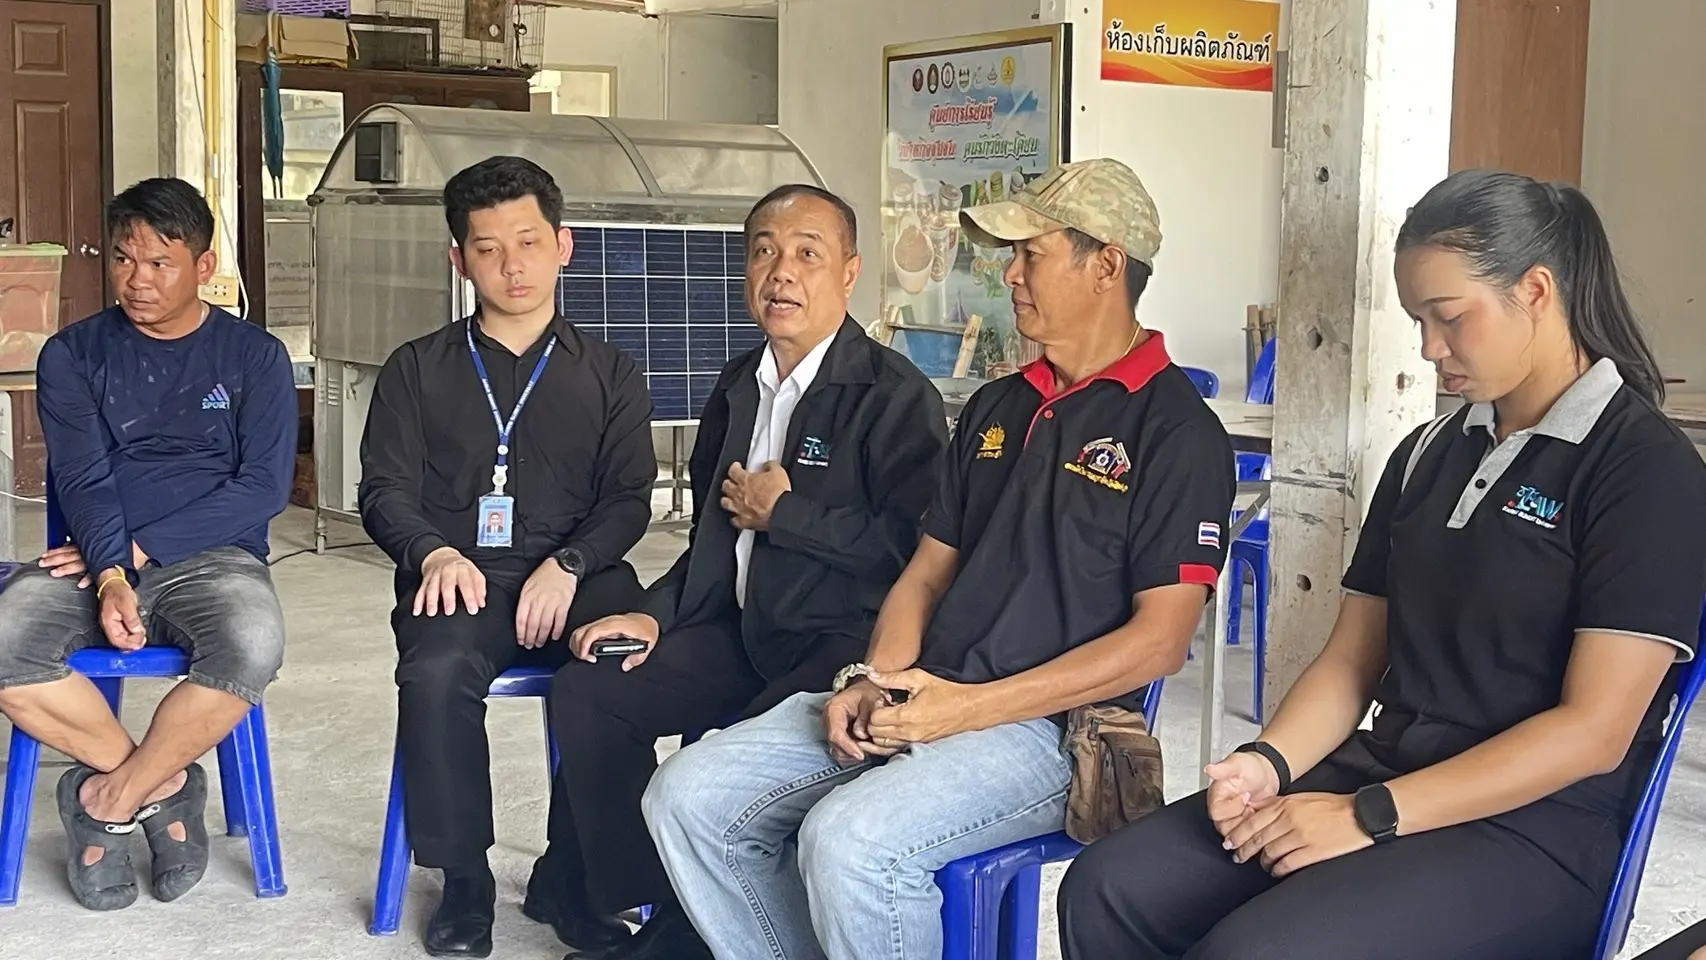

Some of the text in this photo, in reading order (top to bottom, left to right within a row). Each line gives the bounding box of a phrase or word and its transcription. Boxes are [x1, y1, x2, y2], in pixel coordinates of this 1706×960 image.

[1106, 20, 1272, 62] ห้องเก็บผลิตภัณฑ์
[202, 401, 230, 410] SPORT
